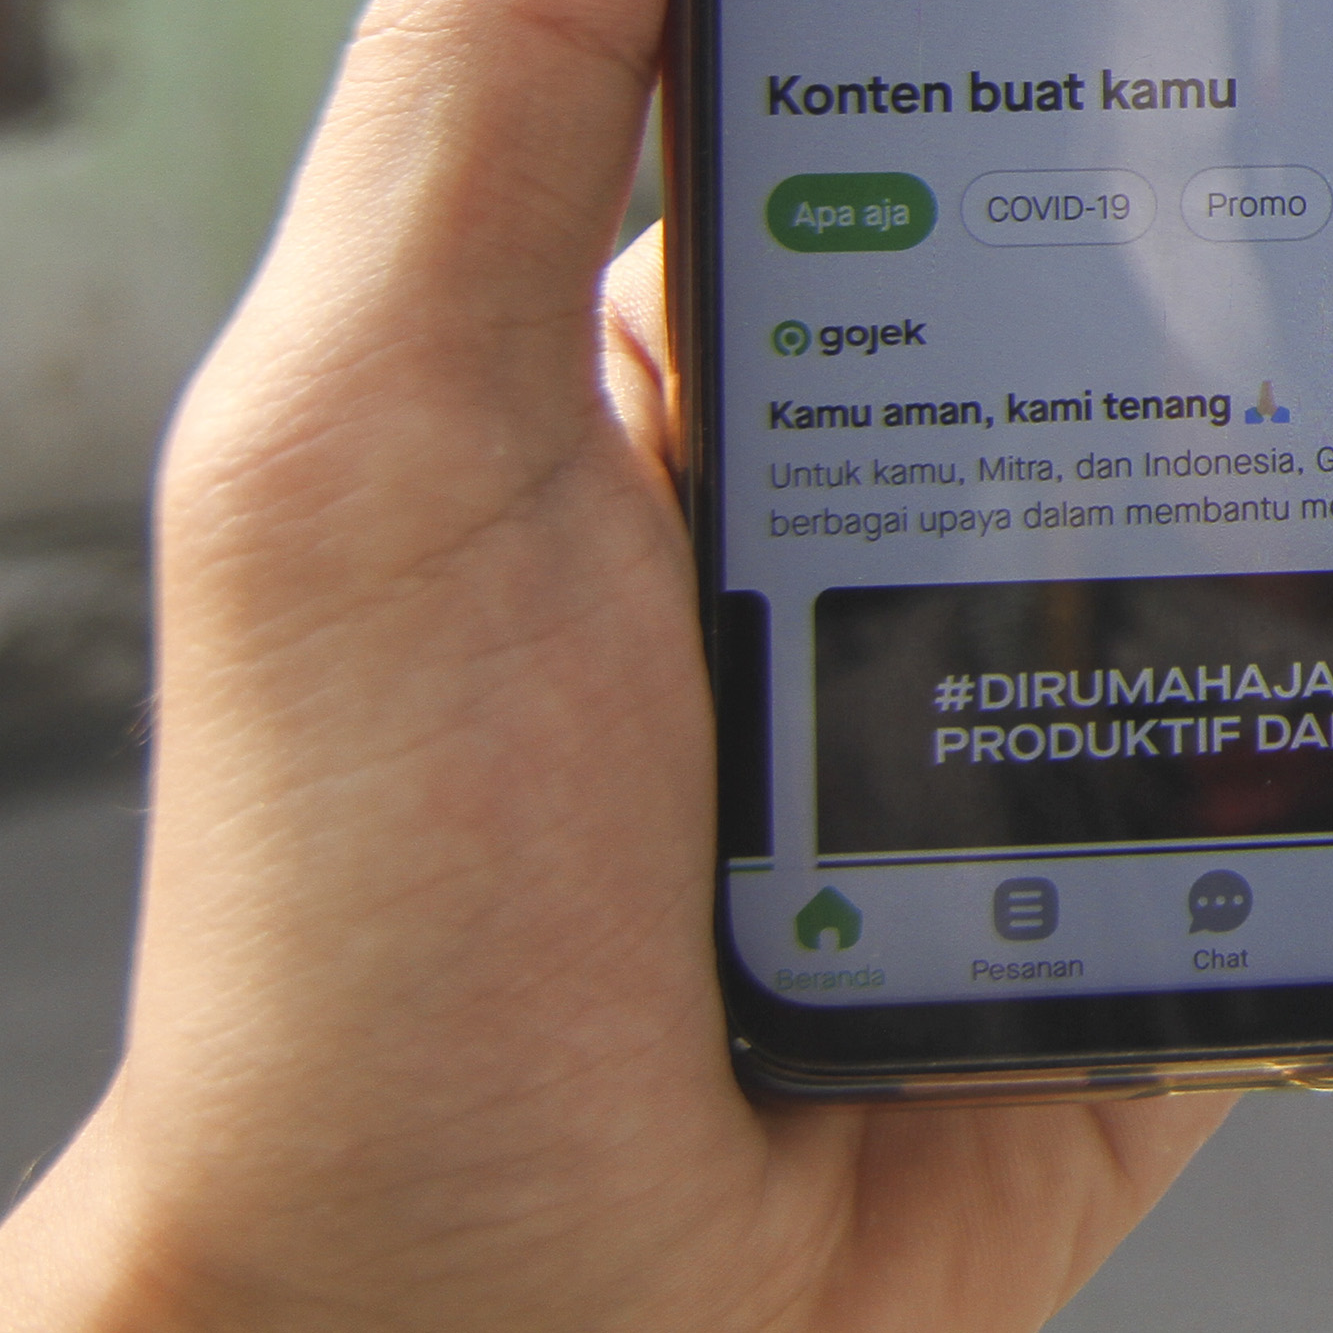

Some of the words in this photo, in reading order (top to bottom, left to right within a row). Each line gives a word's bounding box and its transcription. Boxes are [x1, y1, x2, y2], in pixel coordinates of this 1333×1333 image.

[767, 74, 953, 116] Konten
[970, 72, 1085, 113] buat
[1101, 70, 1237, 110] kamu
[792, 199, 856, 232] Apa
[864, 198, 911, 231] aja
[987, 193, 1131, 223] COVID-19
[1208, 190, 1307, 219] Promo
[820, 318, 926, 355] gojek
[769, 398, 873, 431] Kamu
[882, 399, 994, 431] aman,
[1007, 391, 1093, 423] kami
[1102, 391, 1232, 427] tenang
[771, 458, 862, 491] Untuk
[873, 457, 966, 488] kamu,
[978, 453, 1064, 484] Mitra,
[1076, 451, 1133, 481] dan
[1142, 447, 1304, 479] Indonesia,
[769, 507, 908, 541] berbagai
[919, 504, 1012, 536] upaya
[1022, 499, 1115, 531] dalam
[1125, 494, 1290, 526] membantu
[934, 714, 1242, 765] PRODUKTIF
[972, 955, 1084, 983] Pesanan
[1193, 946, 1249, 971] Chat
[777, 964, 886, 990] Beranda
